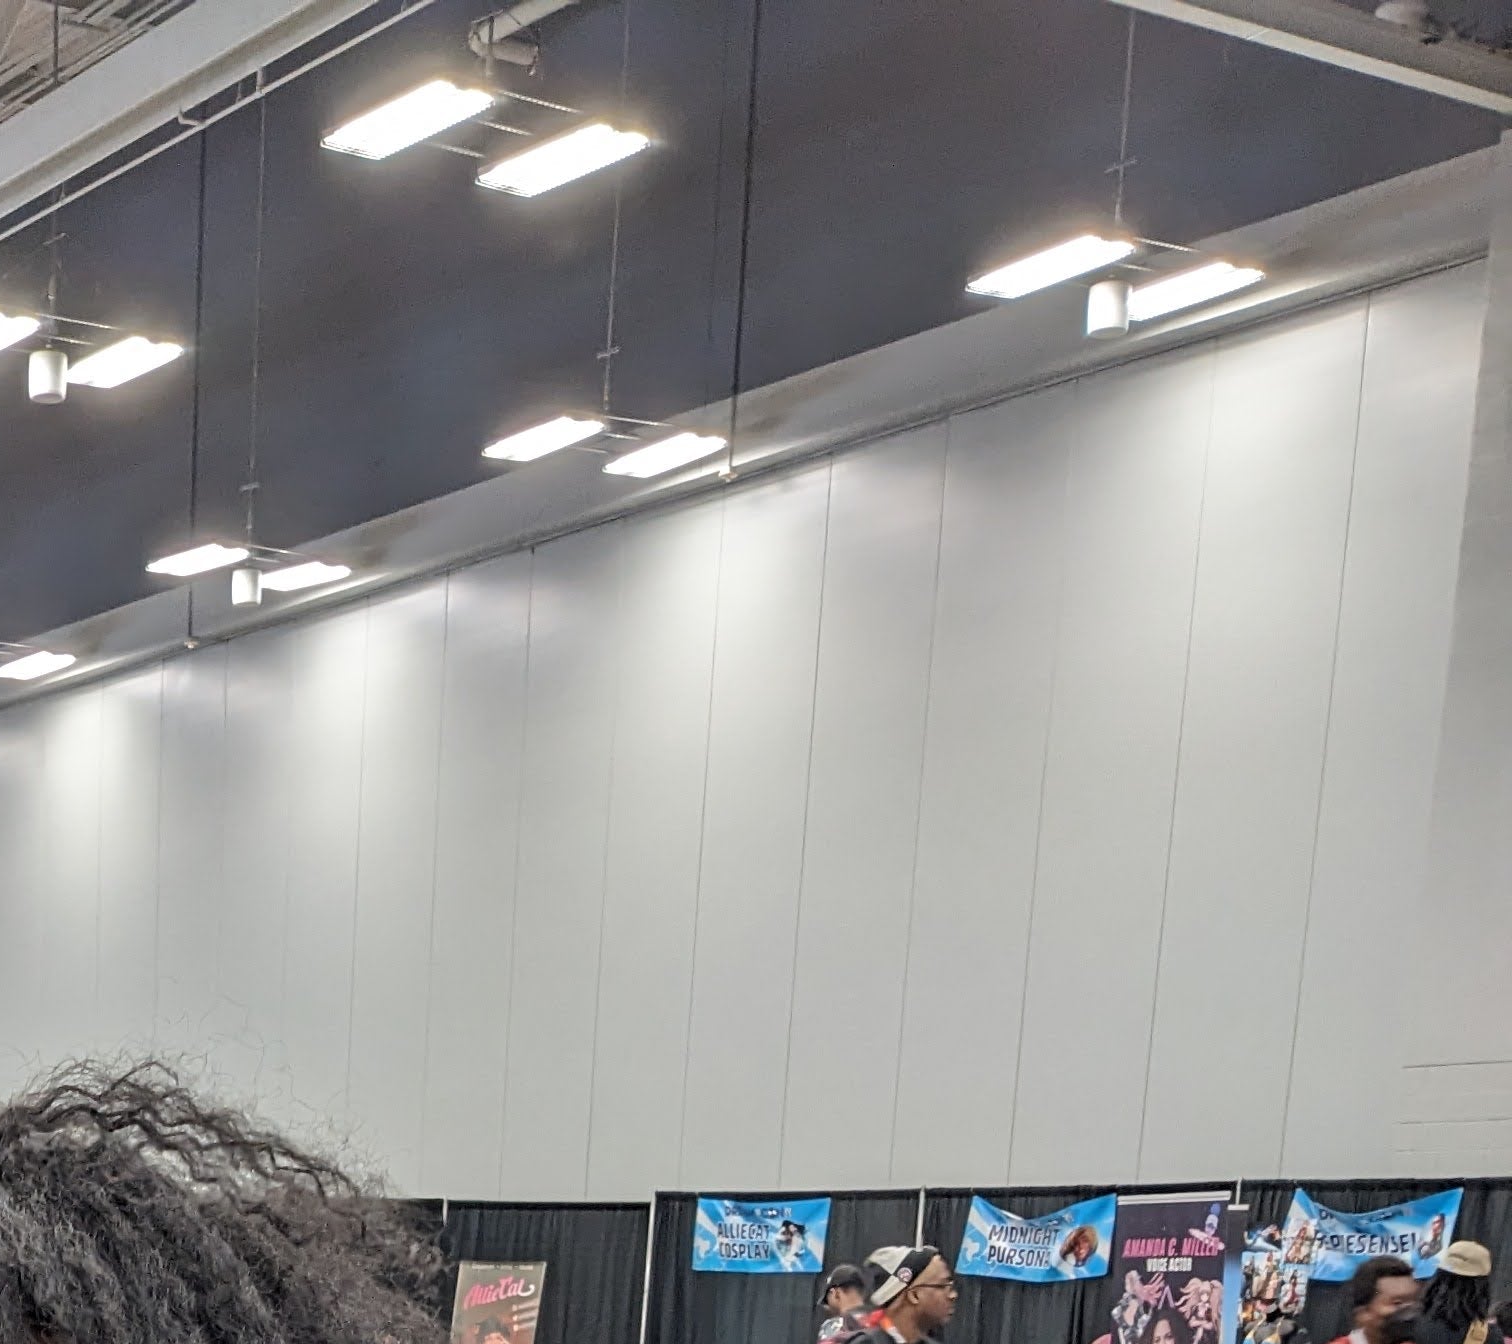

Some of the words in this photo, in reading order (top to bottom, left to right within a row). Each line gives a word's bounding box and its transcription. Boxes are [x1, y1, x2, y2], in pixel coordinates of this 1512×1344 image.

[717, 1222, 770, 1240] ALLIECAT
[988, 1224, 1060, 1247] MIDNIGHT
[718, 1242, 770, 1259] COSPLAY
[1122, 1238, 1166, 1257] AMANDA
[1146, 1258, 1167, 1272] VOICE
[1168, 1257, 1192, 1271] ACTOR
